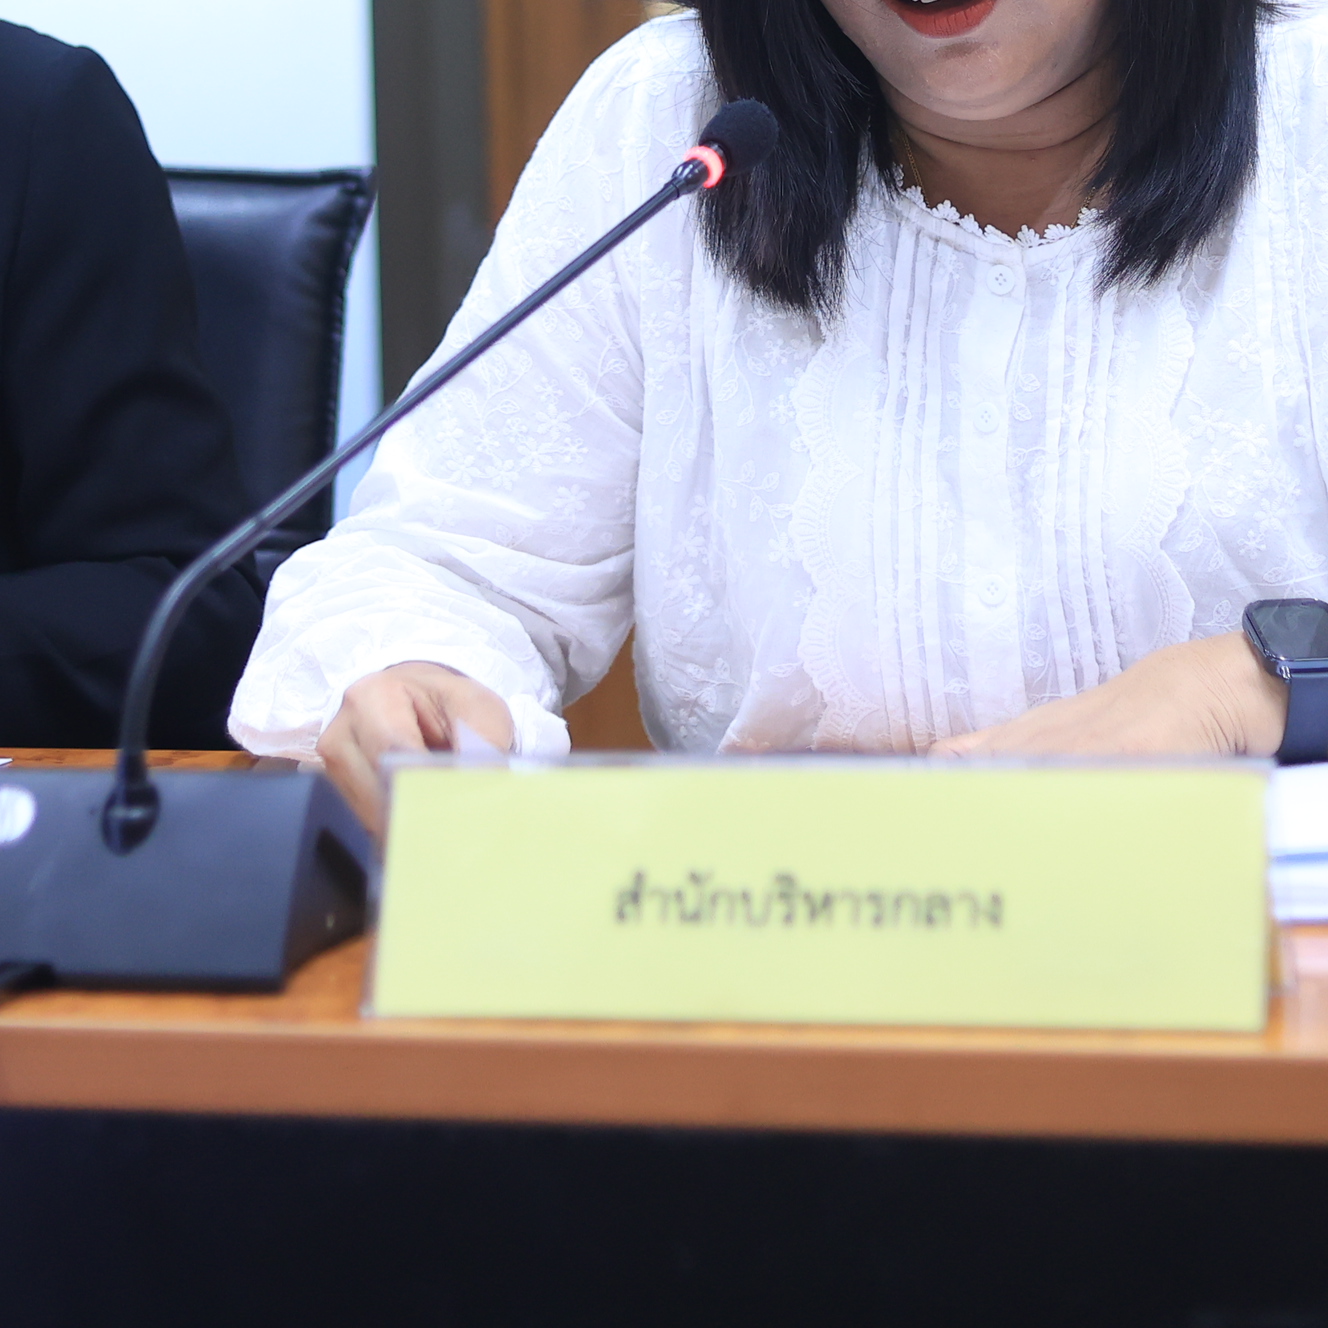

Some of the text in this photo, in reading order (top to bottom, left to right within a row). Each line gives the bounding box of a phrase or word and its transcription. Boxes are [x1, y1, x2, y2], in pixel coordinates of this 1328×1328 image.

[615, 868, 1004, 928] สำนักบริหารกลาง
